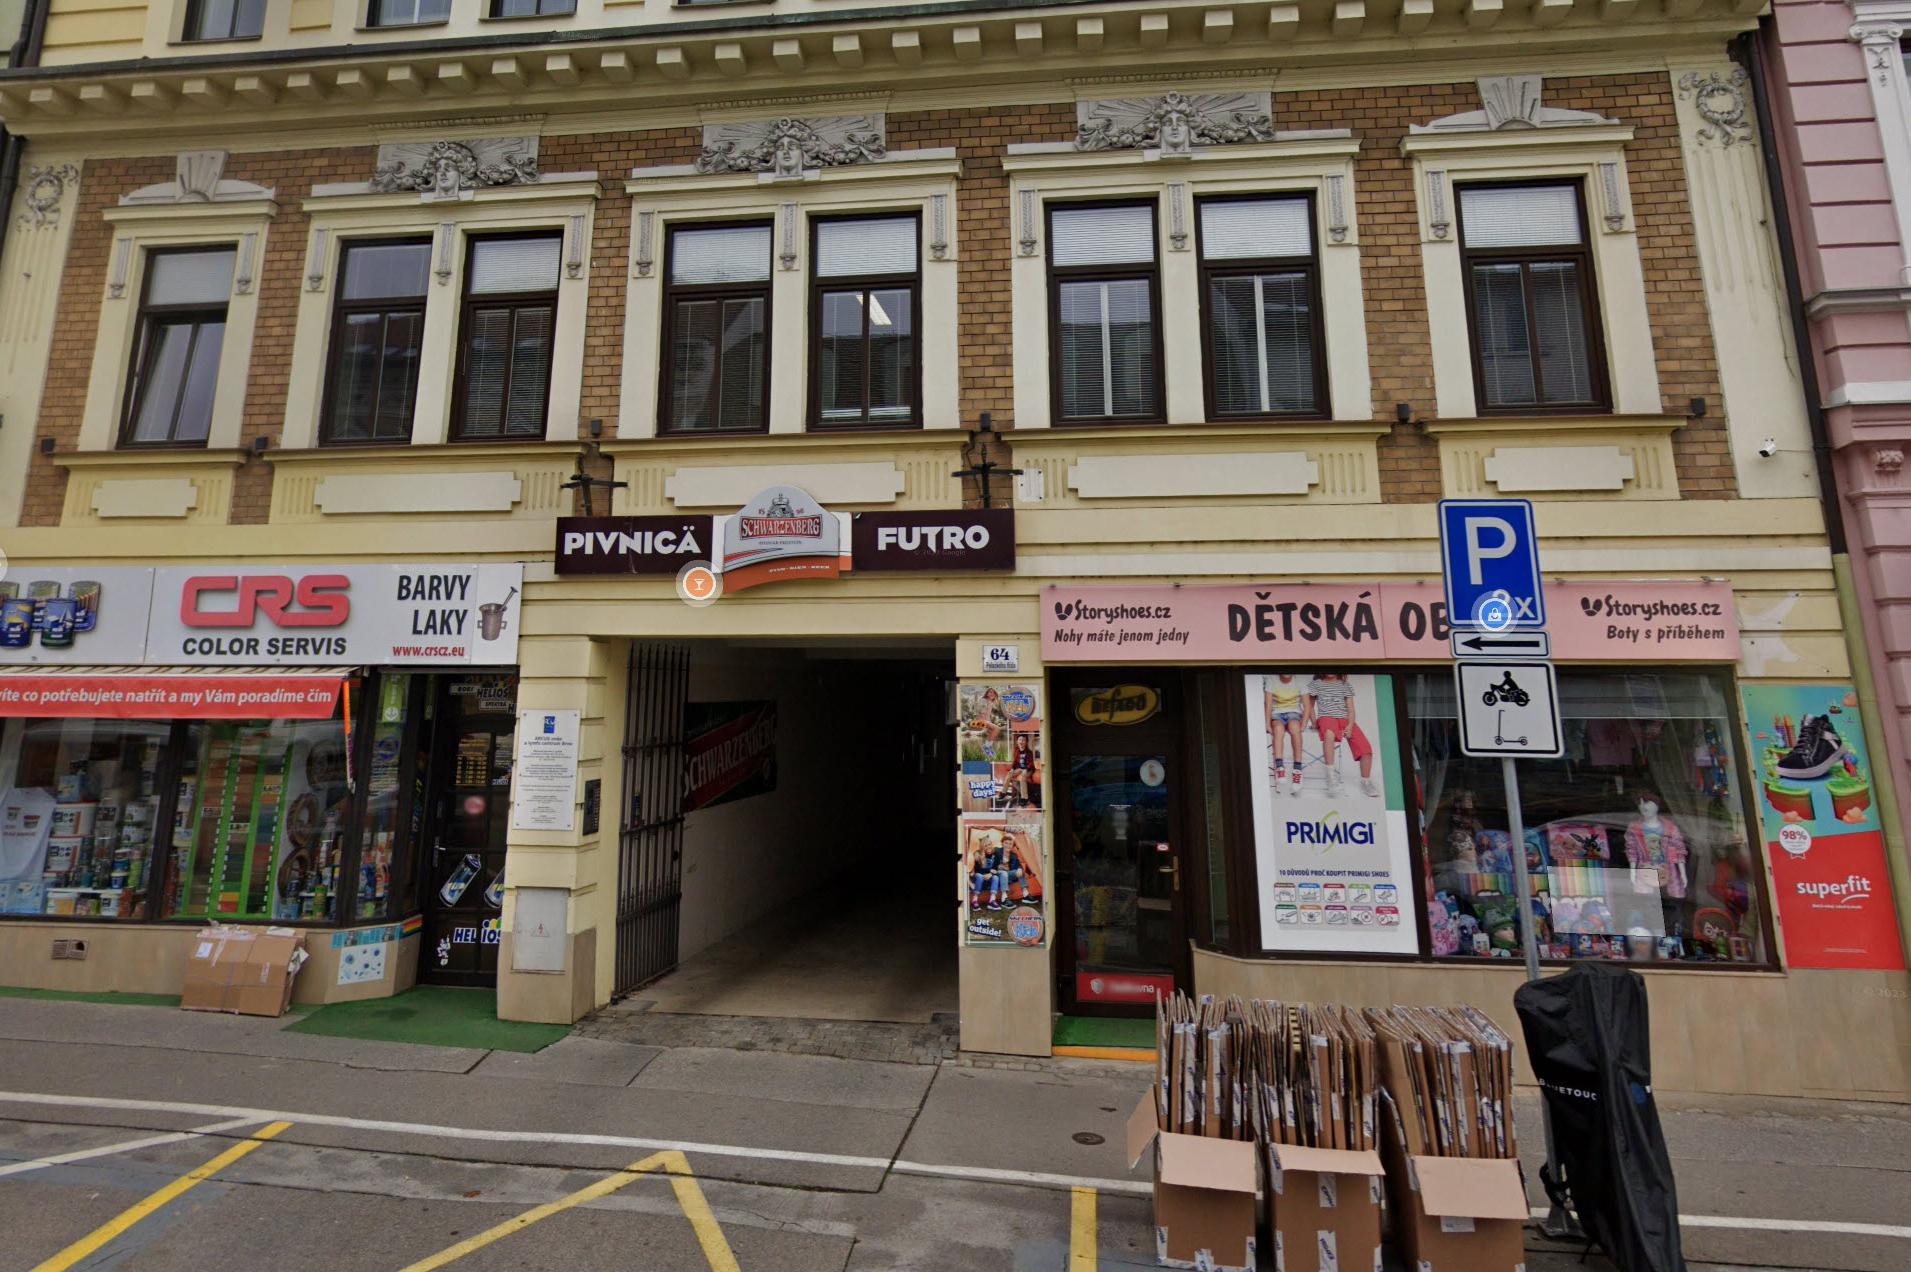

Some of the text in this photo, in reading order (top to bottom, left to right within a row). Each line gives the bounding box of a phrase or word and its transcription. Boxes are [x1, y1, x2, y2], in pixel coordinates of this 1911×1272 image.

[742, 518, 820, 537] SCHWARZENBERG
[564, 525, 701, 555] PIVNICÄ
[878, 525, 990, 553] FUTRO
[1465, 517, 1517, 585] P
[397, 575, 471, 600] BARVY
[180, 575, 350, 628] CRS
[1604, 594, 1722, 621] Storyshoes.cz
[1074, 599, 1172, 624] Storyshoes.cz
[1227, 591, 1450, 642] DĚTSKÁ OB
[412, 609, 468, 635] LAKY
[1054, 628, 1190, 645] Nohy máte jenom jedny
[1607, 624, 1726, 641] Boty s příběhem
[182, 637, 347, 656] COLOR SERVIS
[393, 645, 465, 657] www.crscz.eu
[991, 648, 1010, 661] 64
[22, 691, 38, 702] co
[41, 688, 123, 705] potřebujete
[168, 692, 177, 702] a
[181, 692, 202, 706] my
[205, 688, 235, 703] Vám
[477, 688, 508, 698] HELIOS
[969, 780, 996, 790] happy
[1286, 821, 1375, 845] PRIMIGI
[1782, 830, 1808, 841] 98%
[1326, 869, 1347, 877] KOUPIT
[1796, 875, 1872, 899] superfit
[969, 925, 1002, 937] outside!
[976, 918, 990, 926] get
